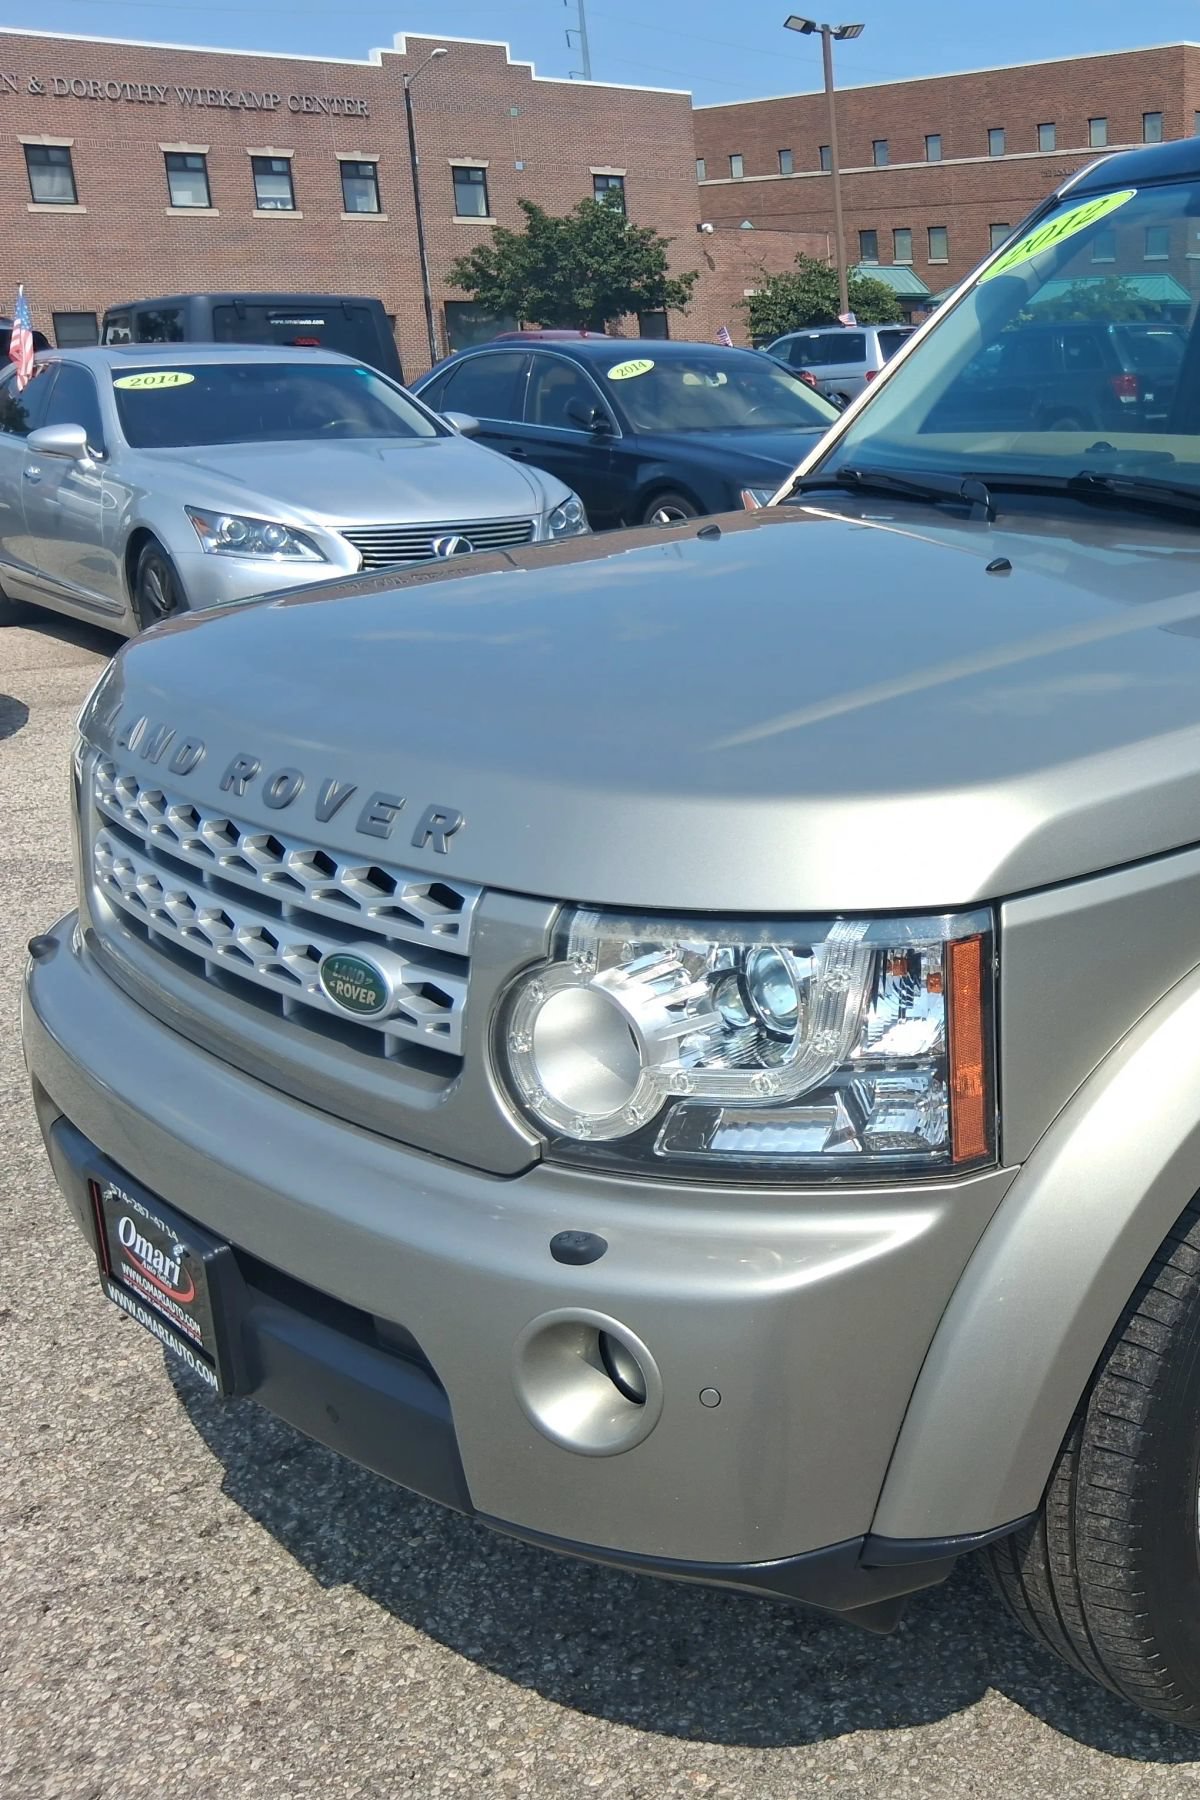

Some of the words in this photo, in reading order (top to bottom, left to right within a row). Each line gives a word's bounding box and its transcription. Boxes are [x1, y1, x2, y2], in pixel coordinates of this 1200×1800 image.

[28, 76, 45, 95] &
[51, 76, 169, 103] DOROTHY
[174, 86, 281, 111] WIEKAMP
[287, 94, 370, 118] CENTER
[996, 198, 1110, 273] 2012
[129, 374, 179, 387] 2014
[617, 361, 647, 376] 2014
[219, 752, 465, 854] ROVER
[336, 979, 376, 1006] ROVER
[118, 1216, 182, 1286] Omari
[121, 1261, 201, 1335] WWW.OMARIAUTO.COM
[107, 1283, 219, 1392] WWW.OMARIAUTO.COM
